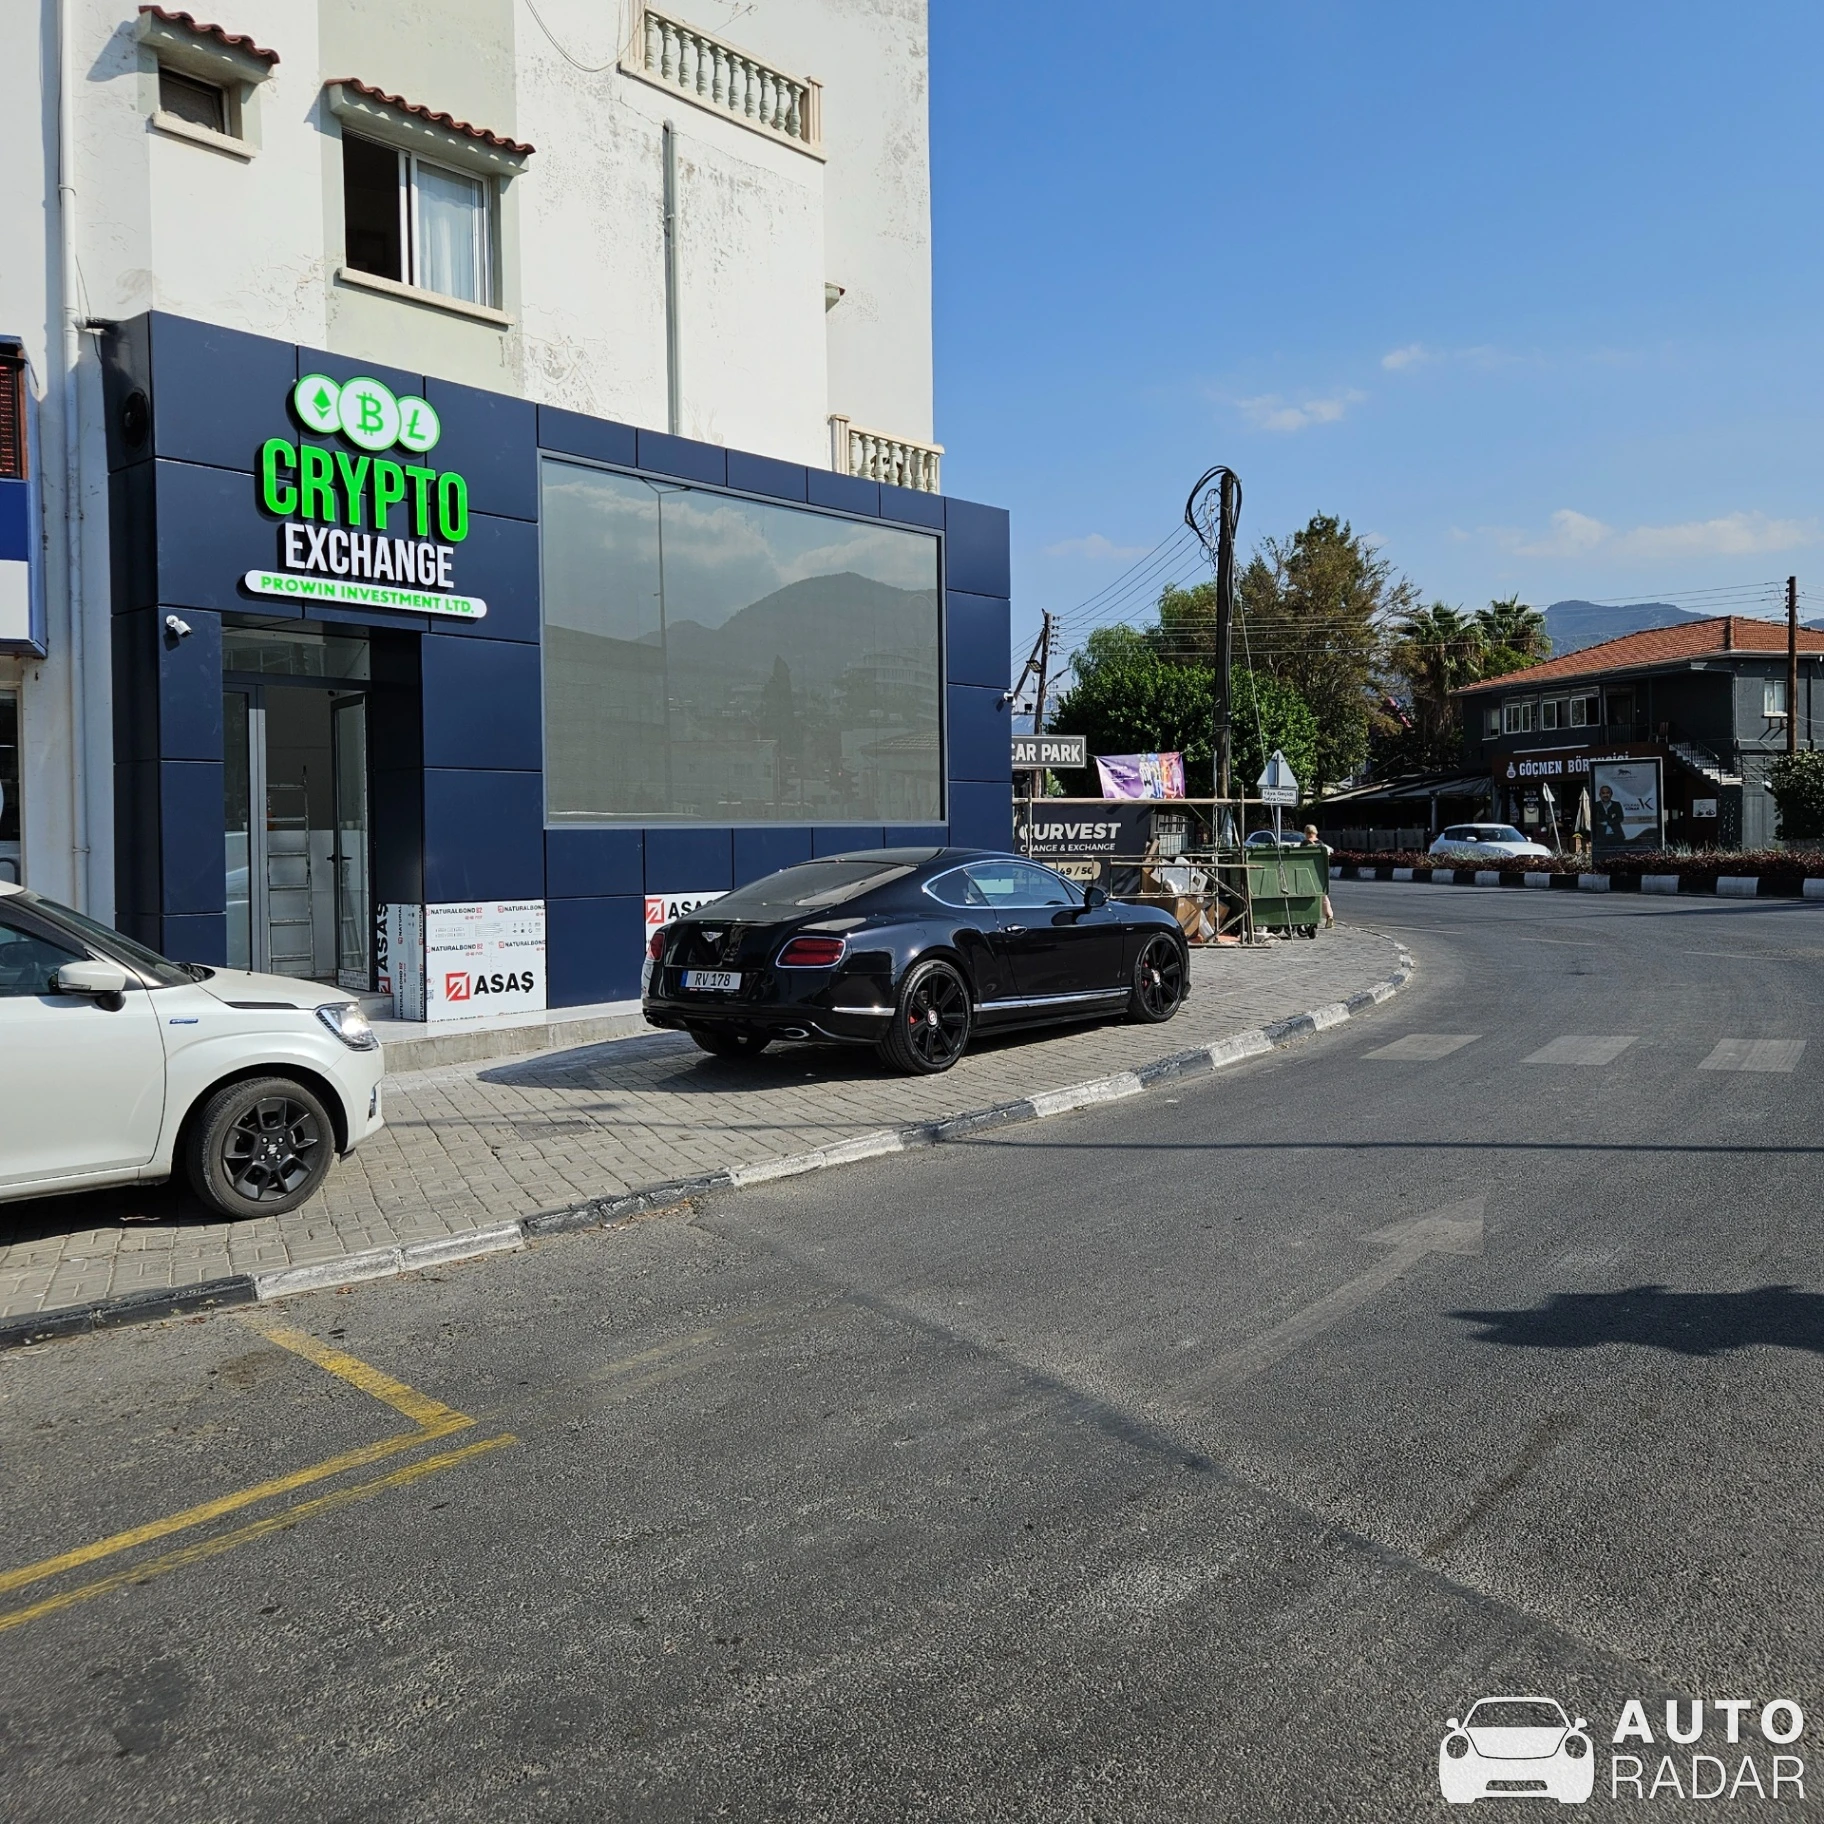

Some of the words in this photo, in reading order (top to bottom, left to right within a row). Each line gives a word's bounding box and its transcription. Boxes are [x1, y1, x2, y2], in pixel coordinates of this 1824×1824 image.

[262, 437, 469, 542] CRYPTO
[284, 522, 455, 588] EXCHANGE
[260, 575, 336, 597] PROWIN
[340, 585, 441, 609] INVESTMENT
[445, 598, 474, 614] LTD.
[1041, 743, 1081, 762] PARK
[1519, 759, 1563, 777] GÖÇMEN
[1059, 844, 1065, 852] &
[1067, 843, 1115, 852] EXCHANGE
[430, 907, 476, 915] NATURALBOND
[431, 944, 476, 952] NATURALBOND
[473, 971, 534, 995] ASAŞ
[694, 972, 709, 986] RV
[710, 973, 731, 987] 178
